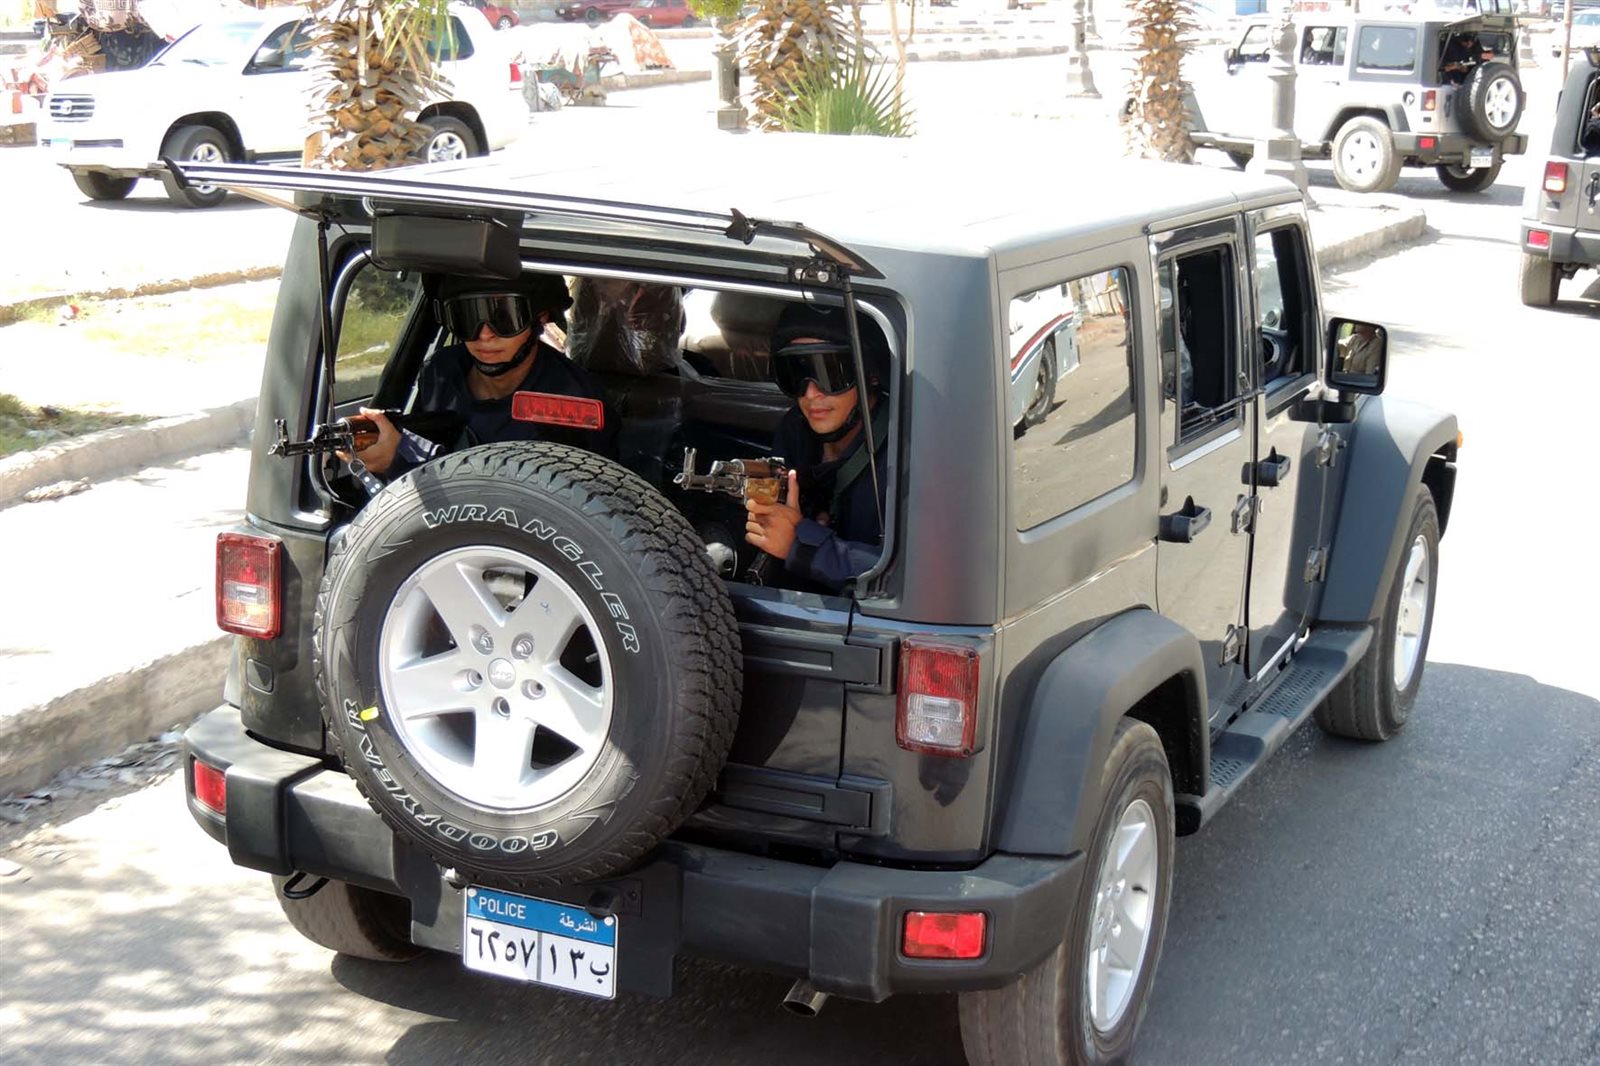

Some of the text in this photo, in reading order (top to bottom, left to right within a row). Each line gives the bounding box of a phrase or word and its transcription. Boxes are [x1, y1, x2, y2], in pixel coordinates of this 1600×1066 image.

[422, 504, 641, 654] WRANGLER
[344, 698, 559, 853] GOODYEAR
[479, 897, 526, 919] POLICE
[559, 912, 597, 932] الشرطة
[471, 927, 537, 969] ٦٢٥٧
